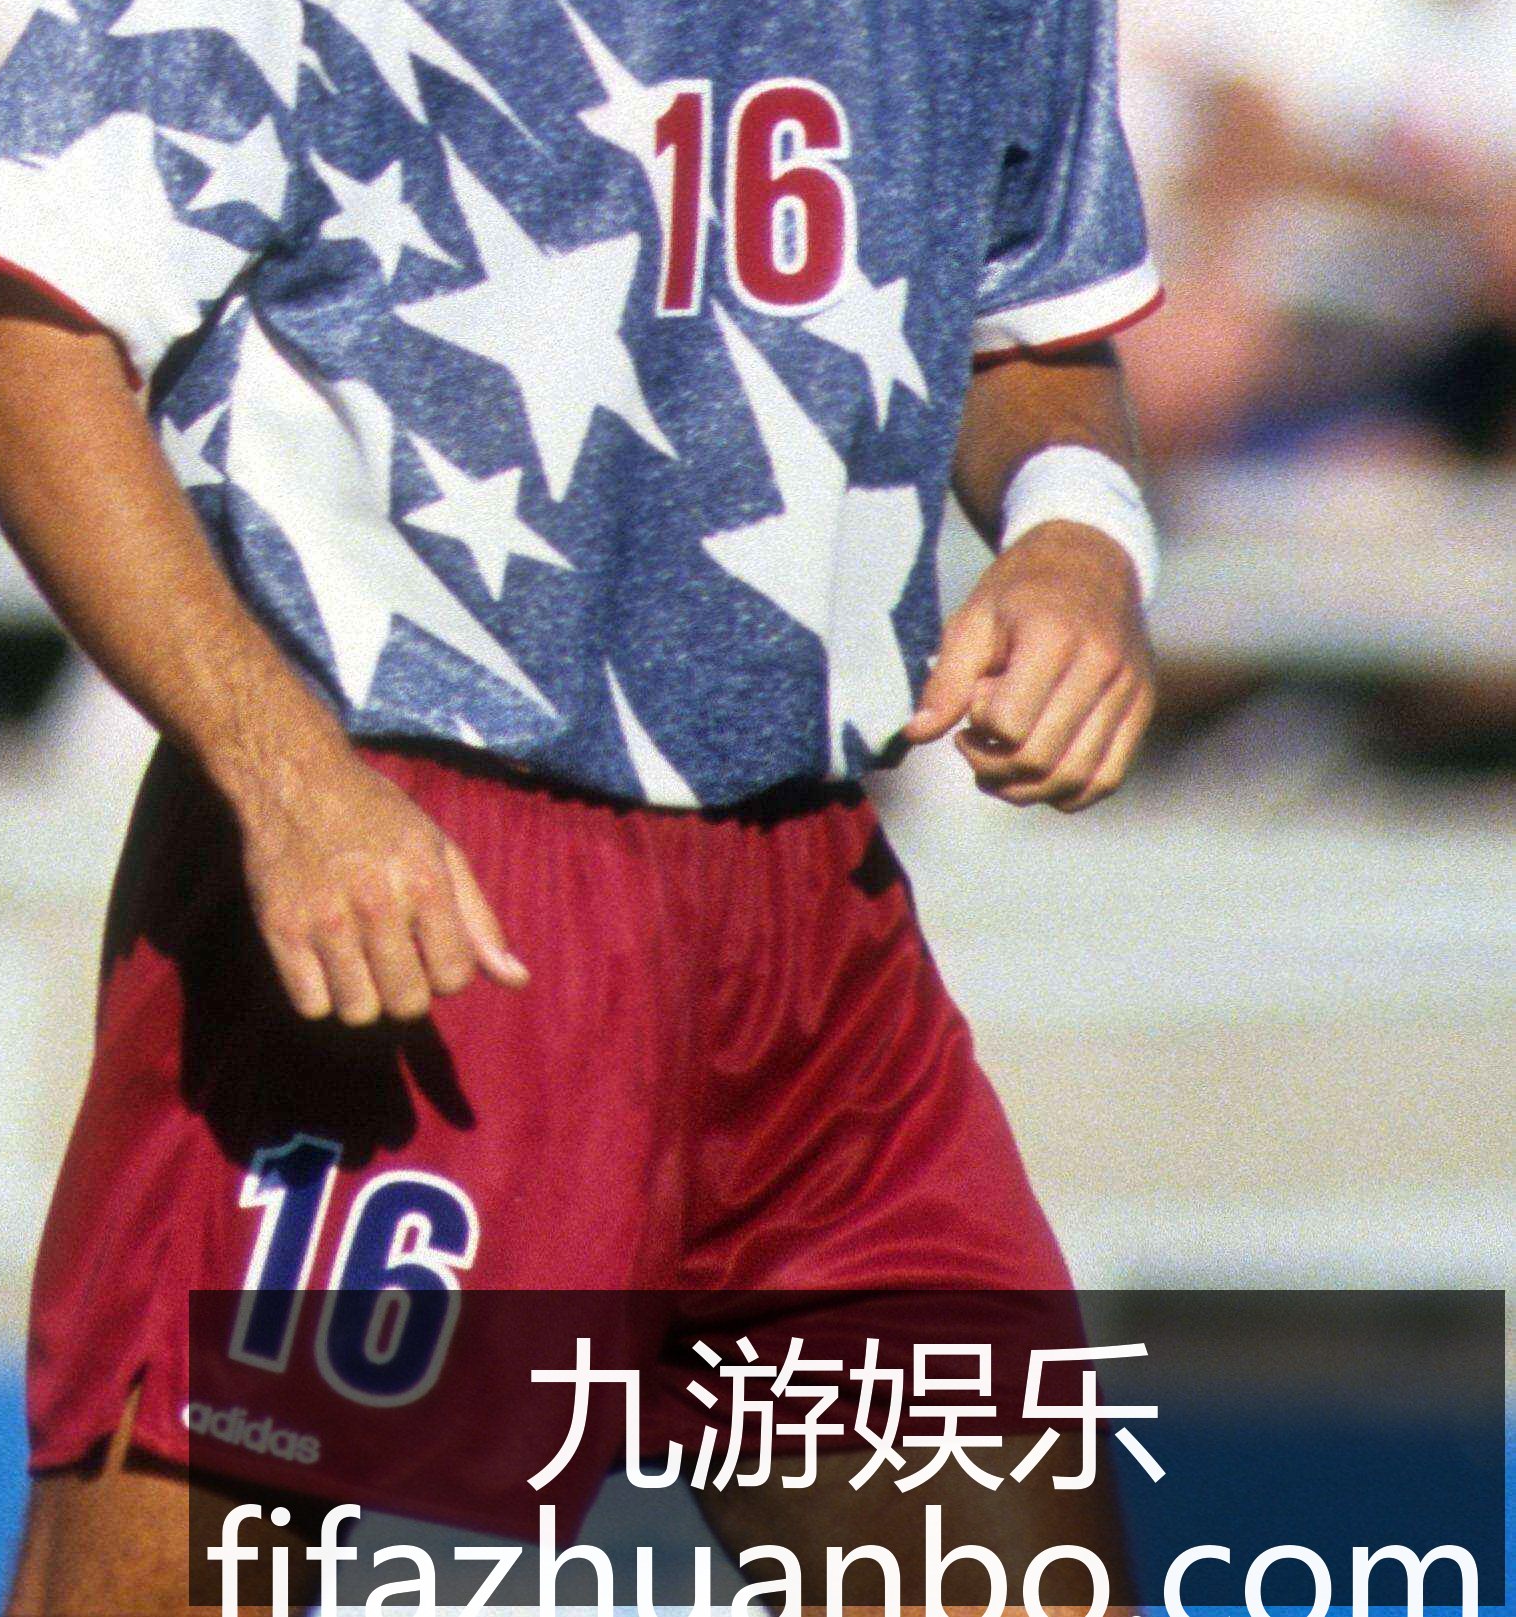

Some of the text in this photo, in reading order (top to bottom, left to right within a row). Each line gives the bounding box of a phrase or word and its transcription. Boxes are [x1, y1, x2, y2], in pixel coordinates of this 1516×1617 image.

[653, 76, 858, 319] 16
[228, 1132, 481, 1409] 16
[180, 1399, 322, 1465] adidas
